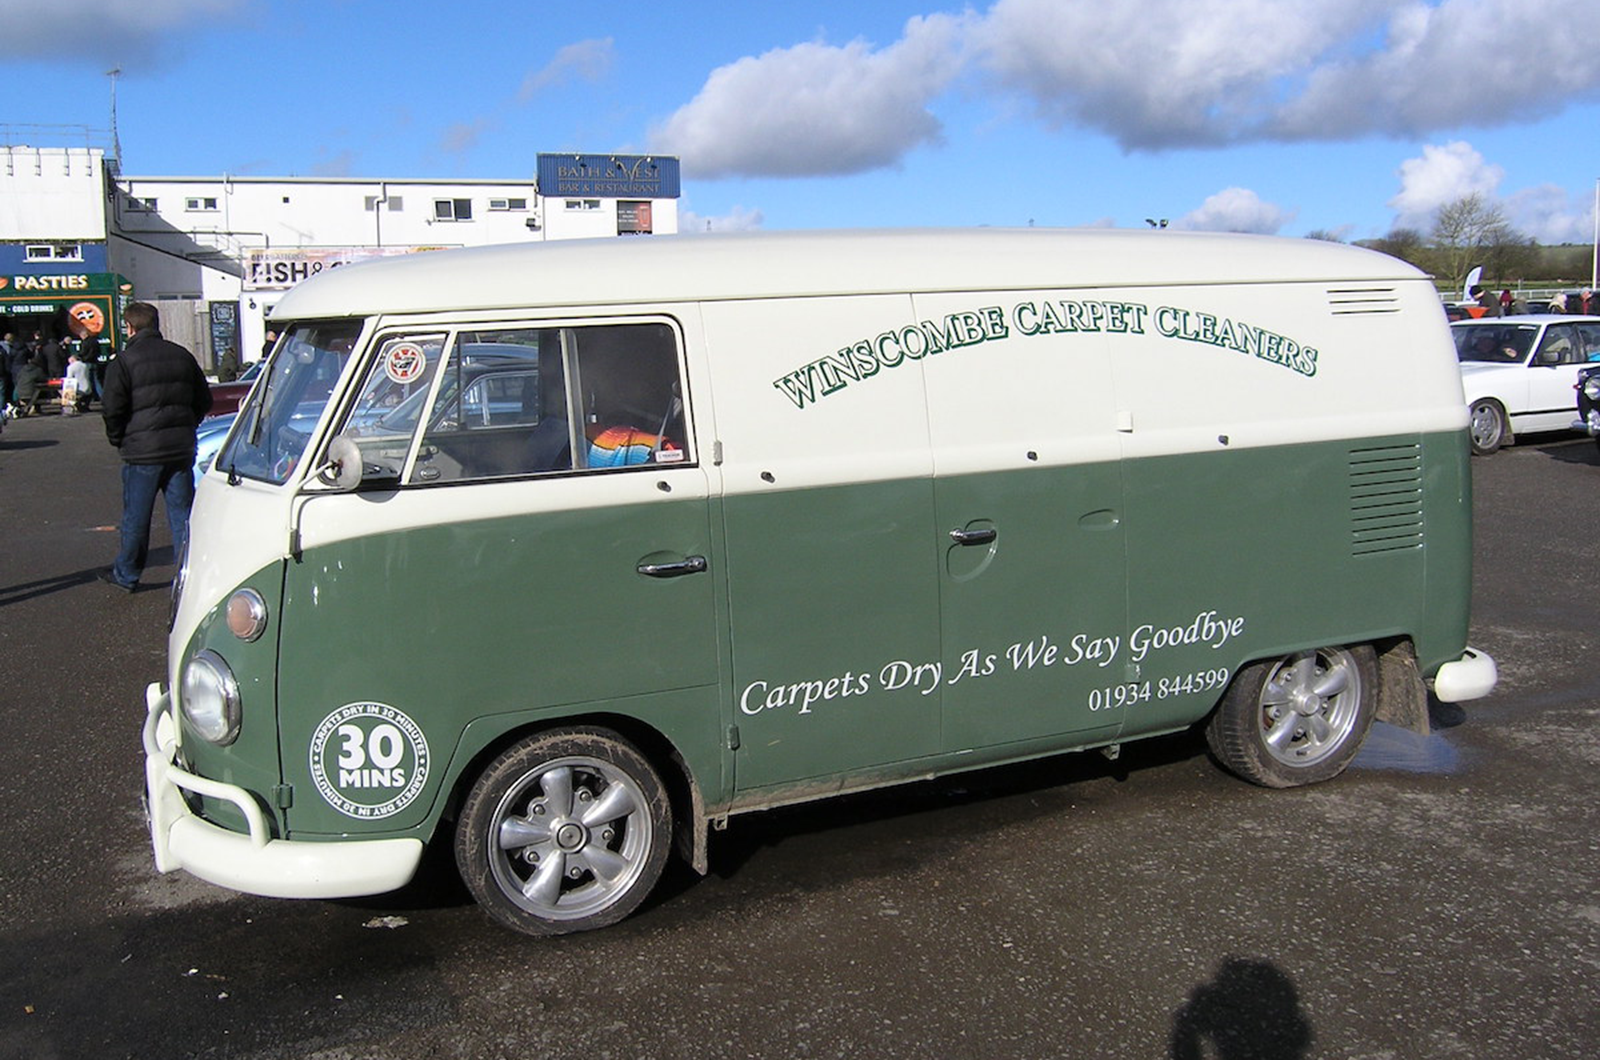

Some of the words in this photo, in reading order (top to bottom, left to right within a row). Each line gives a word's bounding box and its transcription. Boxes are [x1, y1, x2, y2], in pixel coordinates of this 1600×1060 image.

[558, 166, 599, 178] BATH
[605, 168, 615, 178] &
[558, 183, 579, 192] BAR
[582, 183, 590, 192] &
[594, 183, 660, 192] RESTAURANT
[13, 274, 89, 291] PASTIES
[251, 262, 308, 284] FISH
[12, 305, 30, 313] COLD
[30, 304, 54, 313] DRINKS
[773, 305, 1008, 410] WINSCOMBE
[1012, 300, 1147, 336] CARPET
[1153, 305, 1319, 377] CLEANERS
[740, 668, 870, 718] Carpets
[880, 660, 942, 697] Dry
[949, 648, 997, 680] As
[1005, 635, 1058, 672] We
[1065, 629, 1120, 667] Say
[1128, 610, 1246, 661] Goodbye
[1087, 682, 1152, 713] 01934
[1157, 668, 1230, 699] 844599
[313, 712, 343, 753] CARPETS
[342, 705, 365, 717] DRY
[367, 705, 379, 714] IN
[381, 706, 395, 718] 30
[395, 714, 427, 757] MINUTES
[338, 724, 405, 770] 30
[339, 768, 406, 788] MINS
